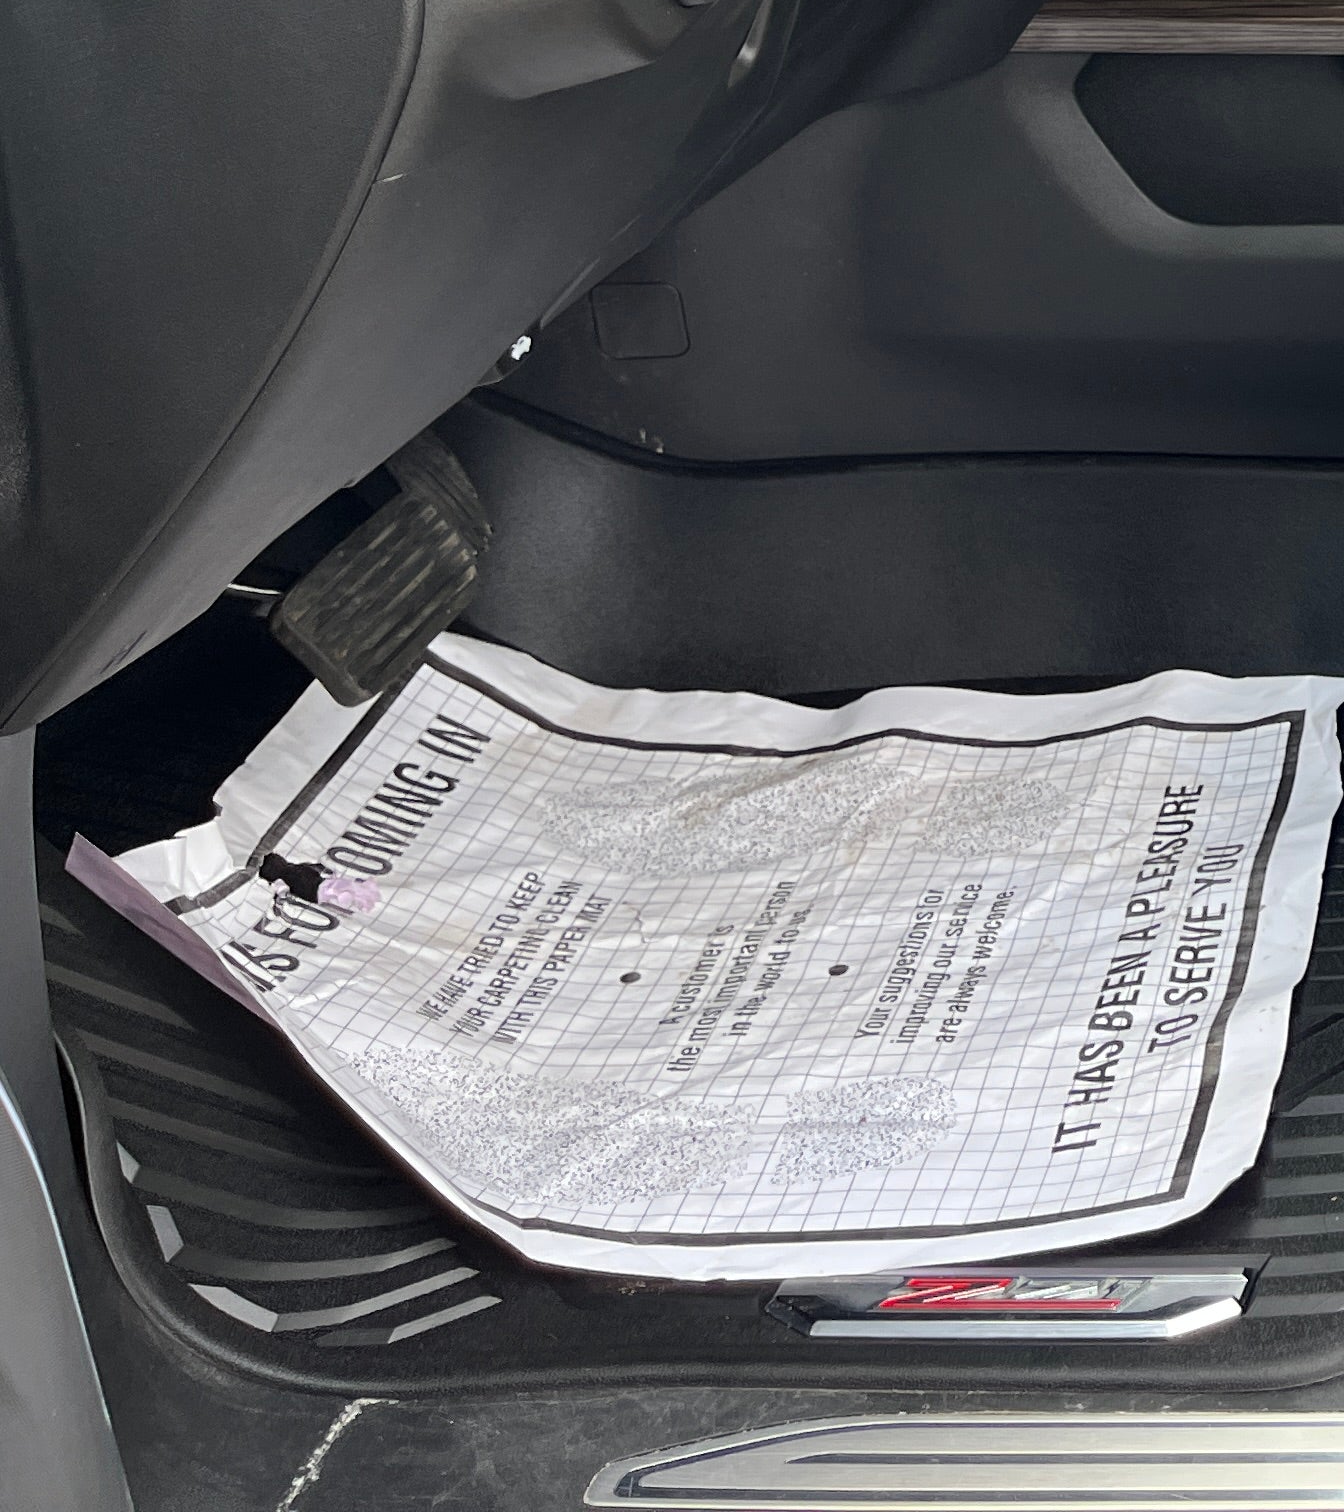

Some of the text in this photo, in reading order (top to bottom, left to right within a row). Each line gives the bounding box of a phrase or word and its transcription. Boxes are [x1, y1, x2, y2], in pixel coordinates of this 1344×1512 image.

[254, 887, 354, 949] FO
[318, 762, 460, 882] OMING
[417, 713, 492, 764] IN
[433, 975, 474, 1008] HAVE
[457, 936, 505, 975] TRIED
[488, 913, 521, 933] TO
[506, 872, 546, 912] KEEP
[452, 880, 583, 1038] YOUR CARPETING CLEAN
[517, 976, 559, 1006] THIS
[542, 925, 592, 972] PAPER
[576, 893, 613, 923] MAT
[667, 881, 797, 1072] the most important person
[672, 941, 725, 1013] customer
[708, 923, 735, 939] is
[734, 995, 767, 1017] the
[754, 951, 791, 992] world
[774, 929, 800, 944] to
[853, 889, 945, 1040] Your suggestions for
[889, 883, 983, 1044] improving our service
[935, 885, 1017, 1043] are always welcome.
[1051, 784, 1204, 1155] IT HAS BEEN A PLEASURE
[1147, 843, 1245, 1054] TO SERVE YOU
[722, 1021, 752, 1037] in
